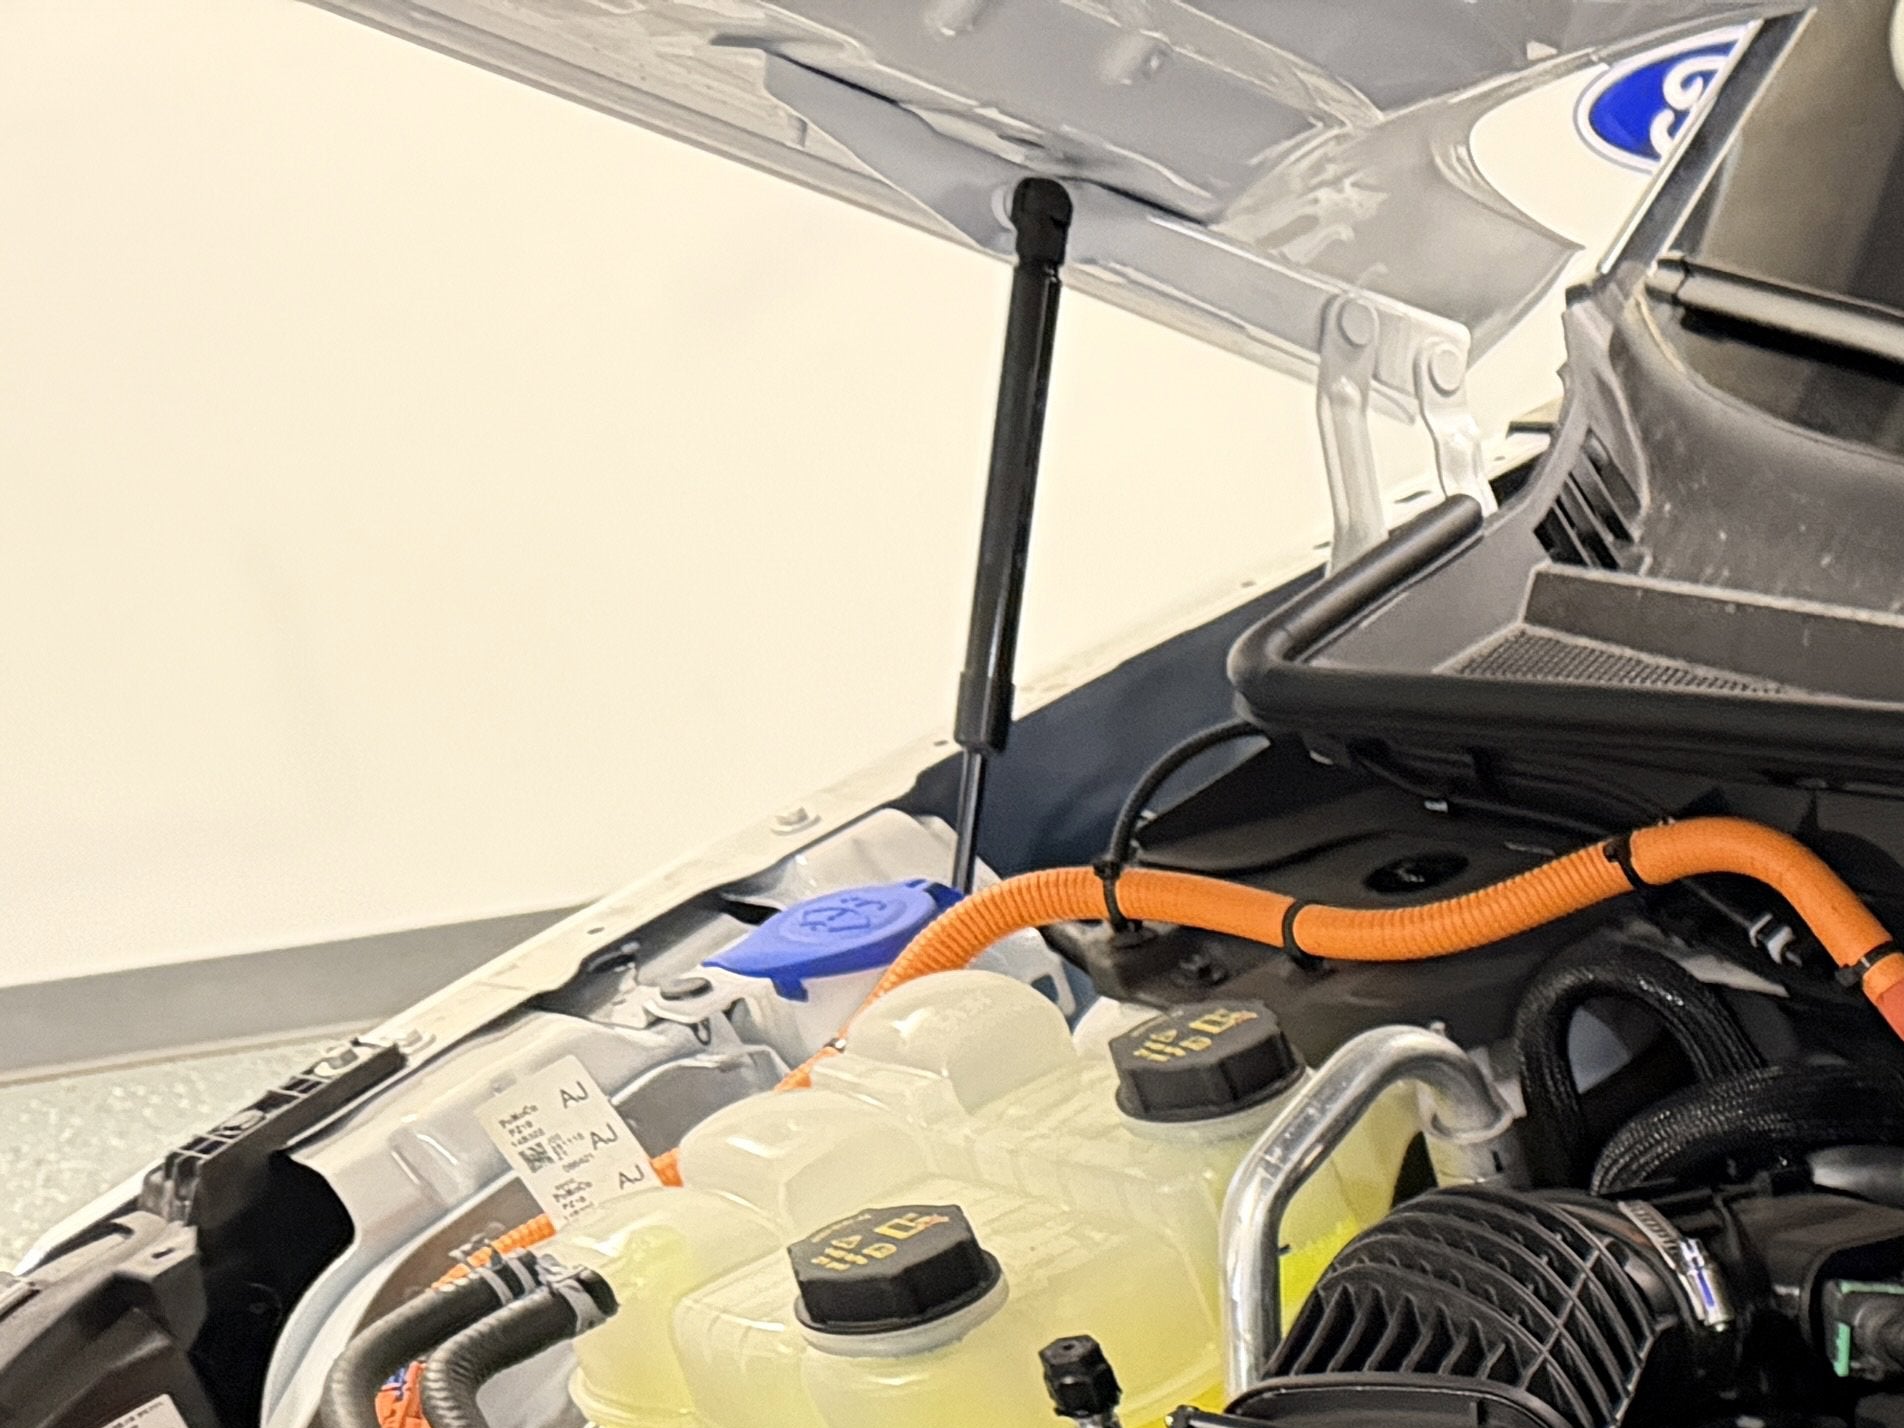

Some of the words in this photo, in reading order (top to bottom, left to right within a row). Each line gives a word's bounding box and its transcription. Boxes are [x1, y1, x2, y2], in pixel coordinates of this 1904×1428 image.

[558, 1080, 589, 1109] AJ
[588, 1122, 618, 1151] AJ
[617, 1163, 645, 1190] AJ
